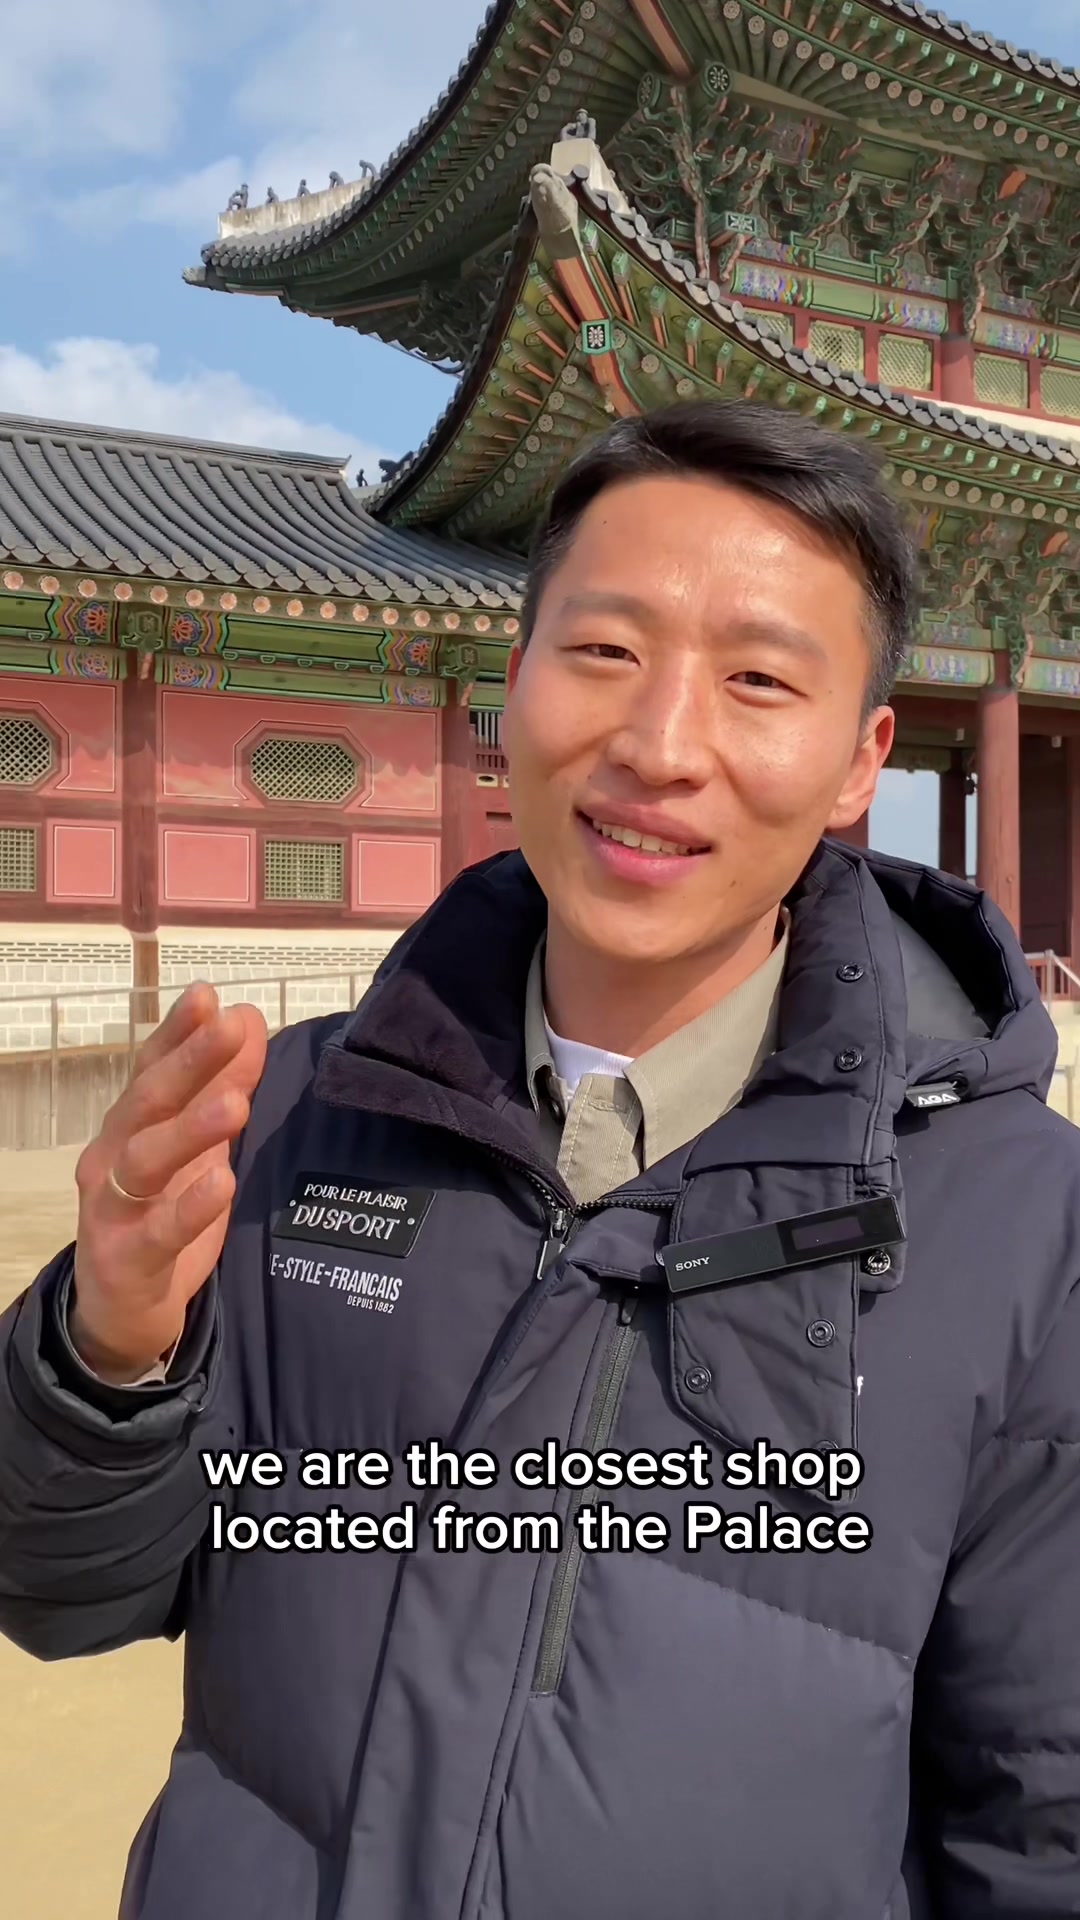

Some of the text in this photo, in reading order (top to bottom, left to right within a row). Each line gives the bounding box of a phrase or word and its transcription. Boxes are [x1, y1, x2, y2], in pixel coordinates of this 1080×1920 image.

[304, 1183, 408, 1211] POUR LE PLAISIR
[675, 1256, 710, 1271] SONY
[269, 1253, 403, 1302] E-STYLE-FRANCAIS
[346, 1294, 395, 1315] DEPUIS 1882
